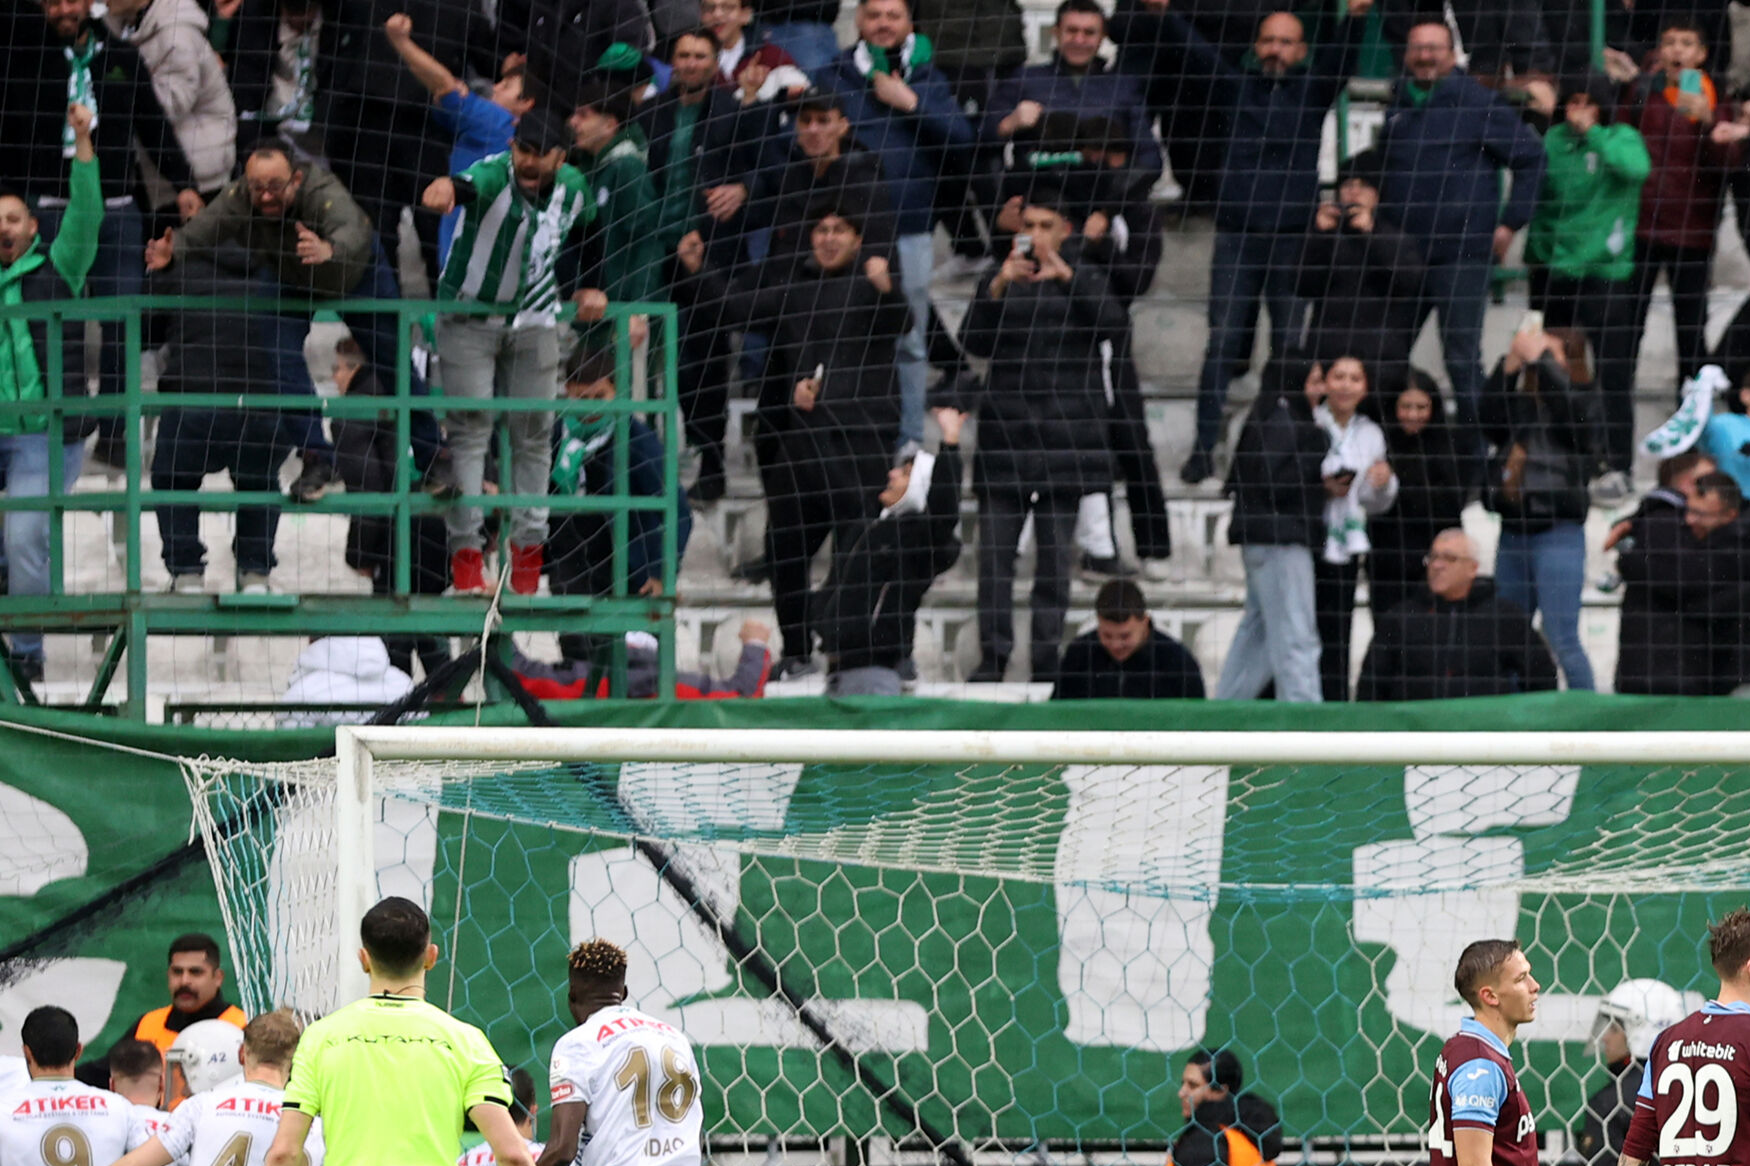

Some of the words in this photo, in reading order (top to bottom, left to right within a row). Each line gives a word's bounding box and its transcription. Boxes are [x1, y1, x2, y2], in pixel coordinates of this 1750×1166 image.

[1682, 1042, 1736, 1061] whitebit
[615, 1046, 697, 1129] 18
[1468, 1094, 1496, 1108] QNB
[1657, 1062, 1738, 1158] 29
